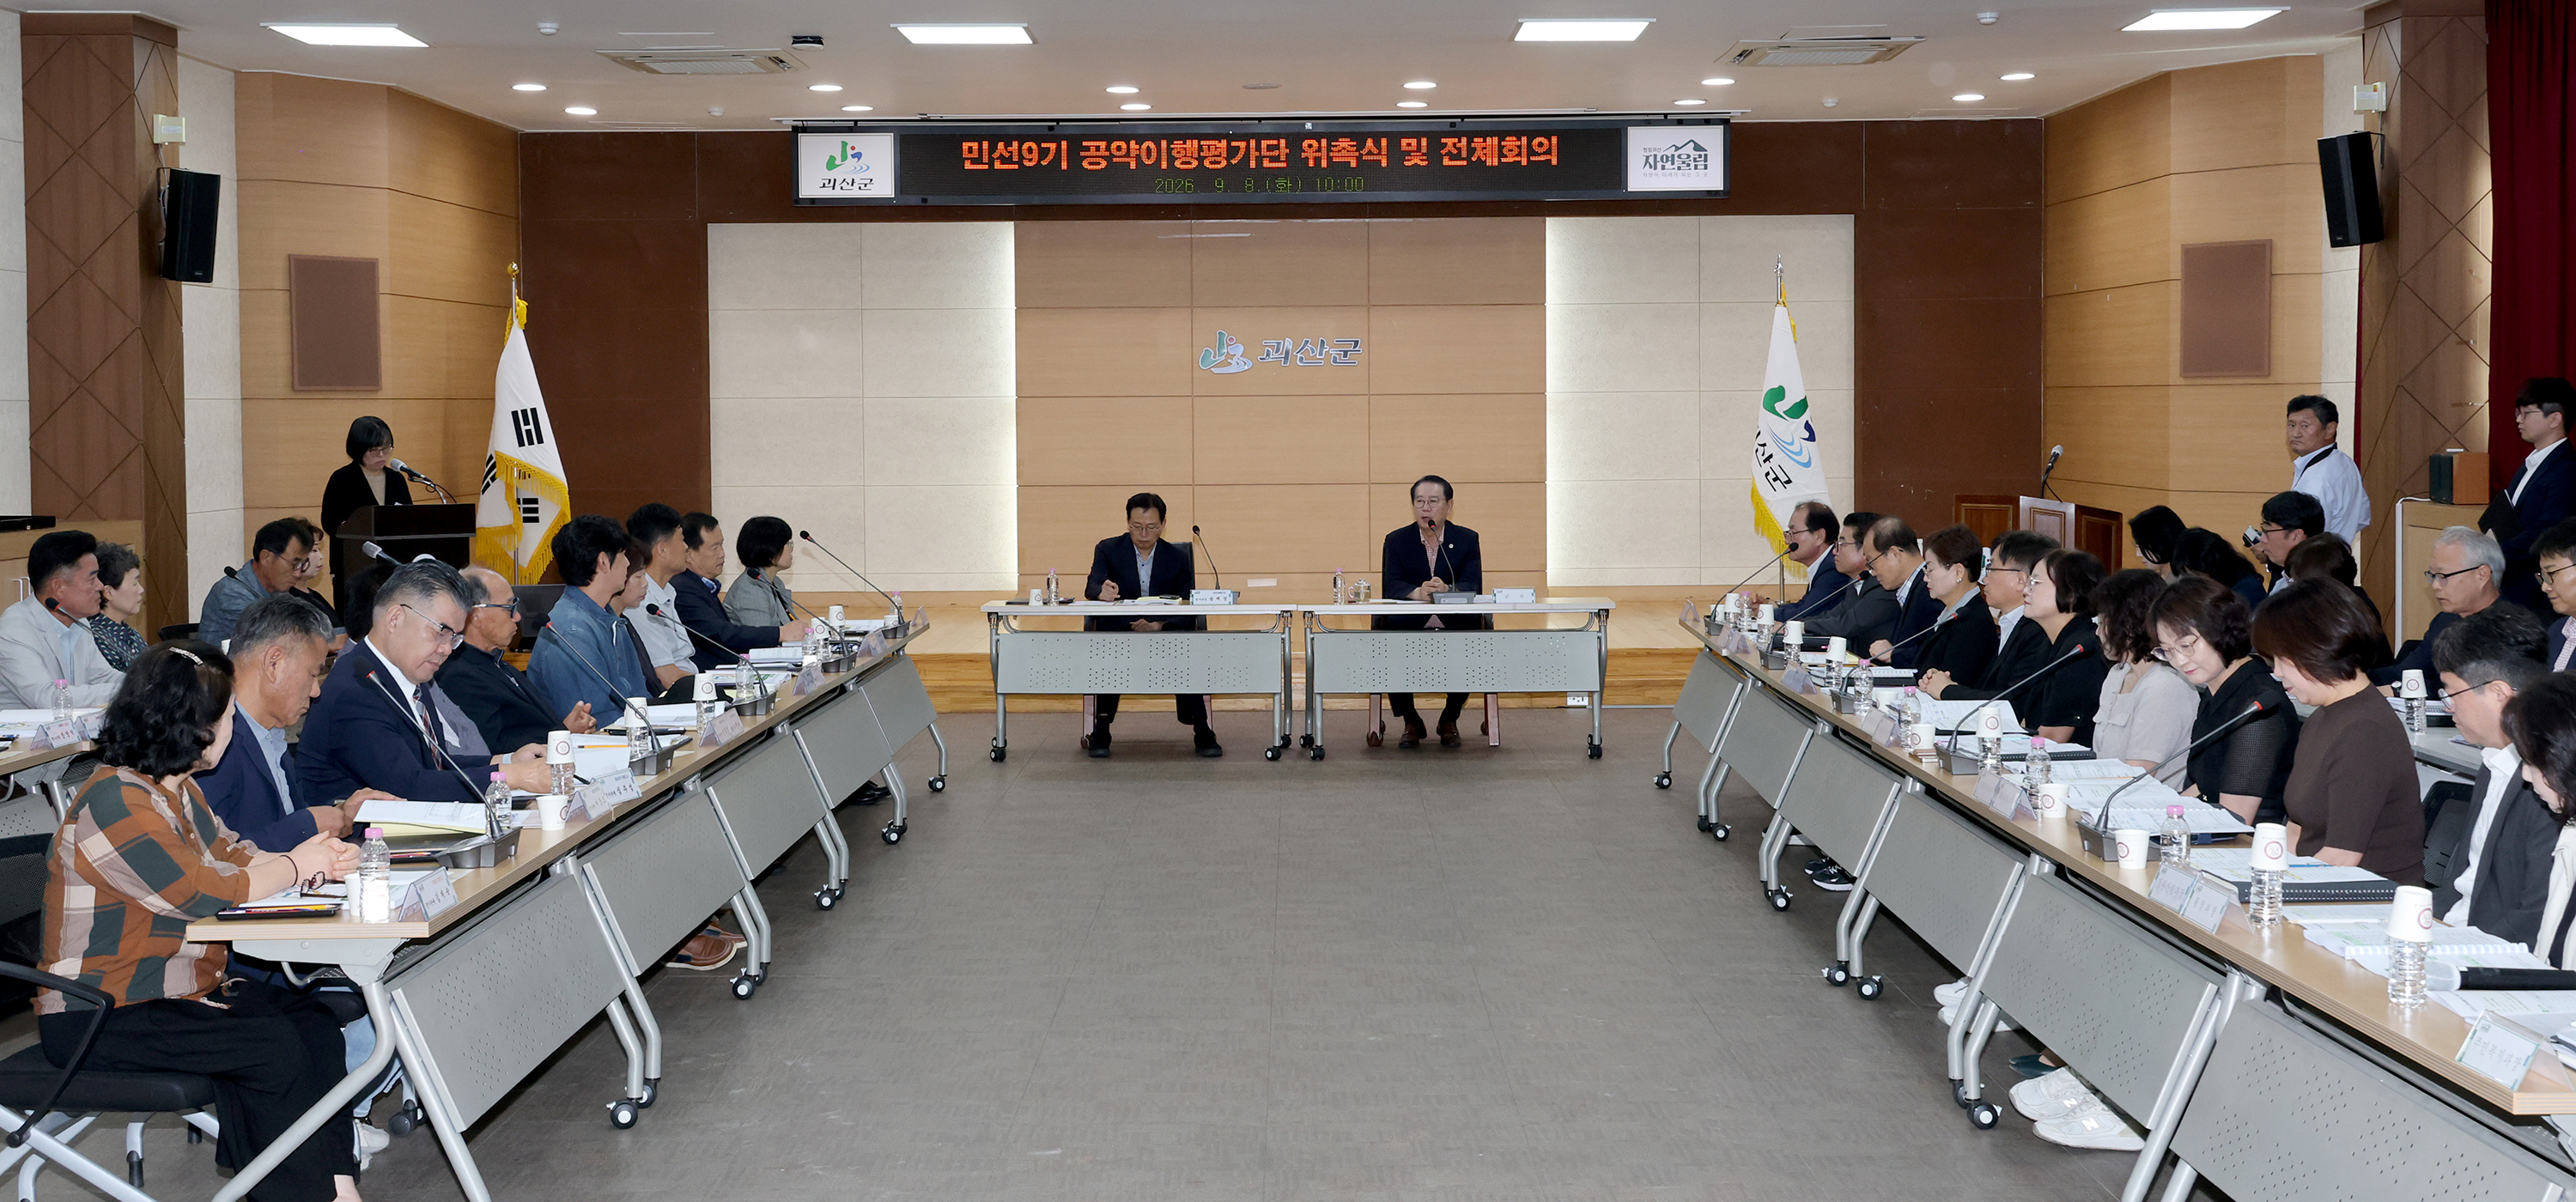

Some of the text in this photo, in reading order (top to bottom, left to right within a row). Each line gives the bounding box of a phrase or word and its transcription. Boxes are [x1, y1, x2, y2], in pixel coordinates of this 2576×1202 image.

[962, 136, 1558, 170] 민선9기 공약이행평가단 위촉식 및 전체회의
[1642, 154, 1709, 170] 자연울림
[819, 178, 874, 191] 괴산군
[1316, 176, 1364, 192] 10:00
[1258, 337, 1363, 367] 괴산군
[1755, 429, 1793, 492] 산군
[2473, 1035, 2523, 1072] 주민복지과장
[2063, 1097, 2078, 1108] N
[2081, 1117, 2099, 1131] N
